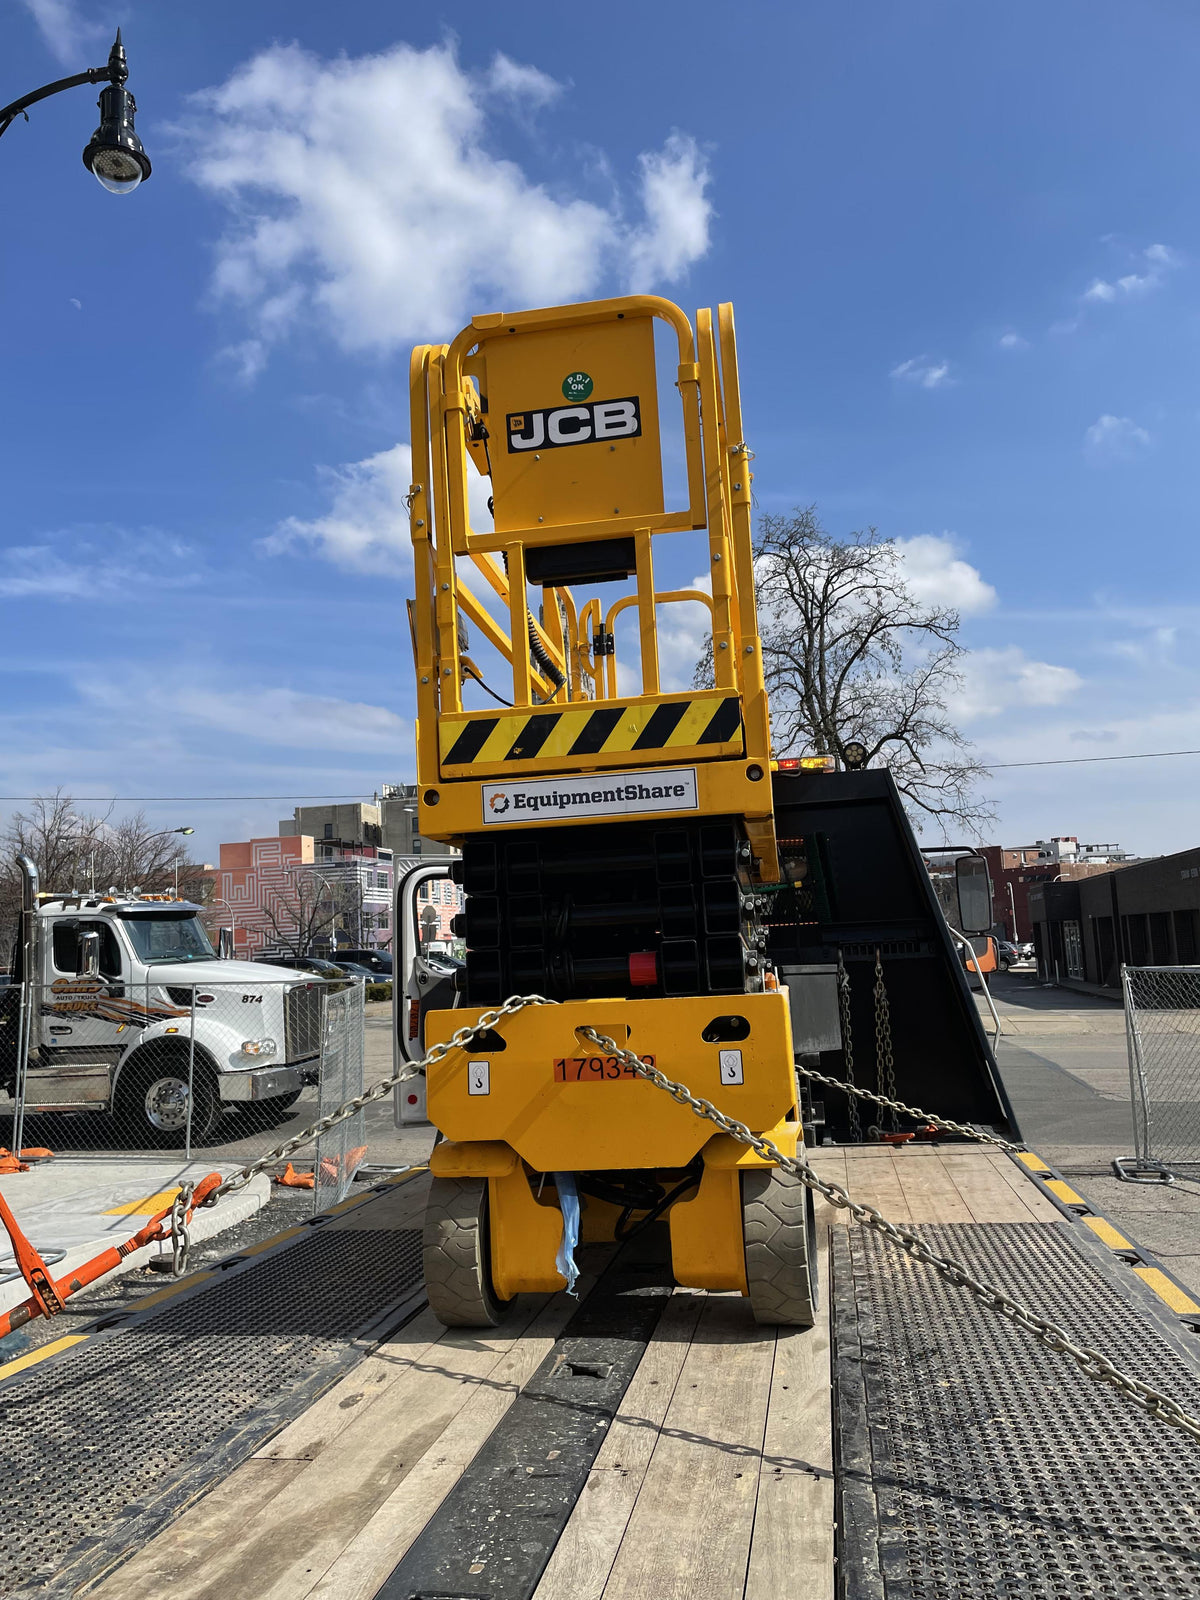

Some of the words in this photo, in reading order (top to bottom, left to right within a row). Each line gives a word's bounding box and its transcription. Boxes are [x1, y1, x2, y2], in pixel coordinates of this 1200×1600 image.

[571, 383, 585, 391] OK
[511, 400, 638, 449] JCB
[513, 783, 686, 811] EquipmentShare
[241, 994, 263, 1004] 874
